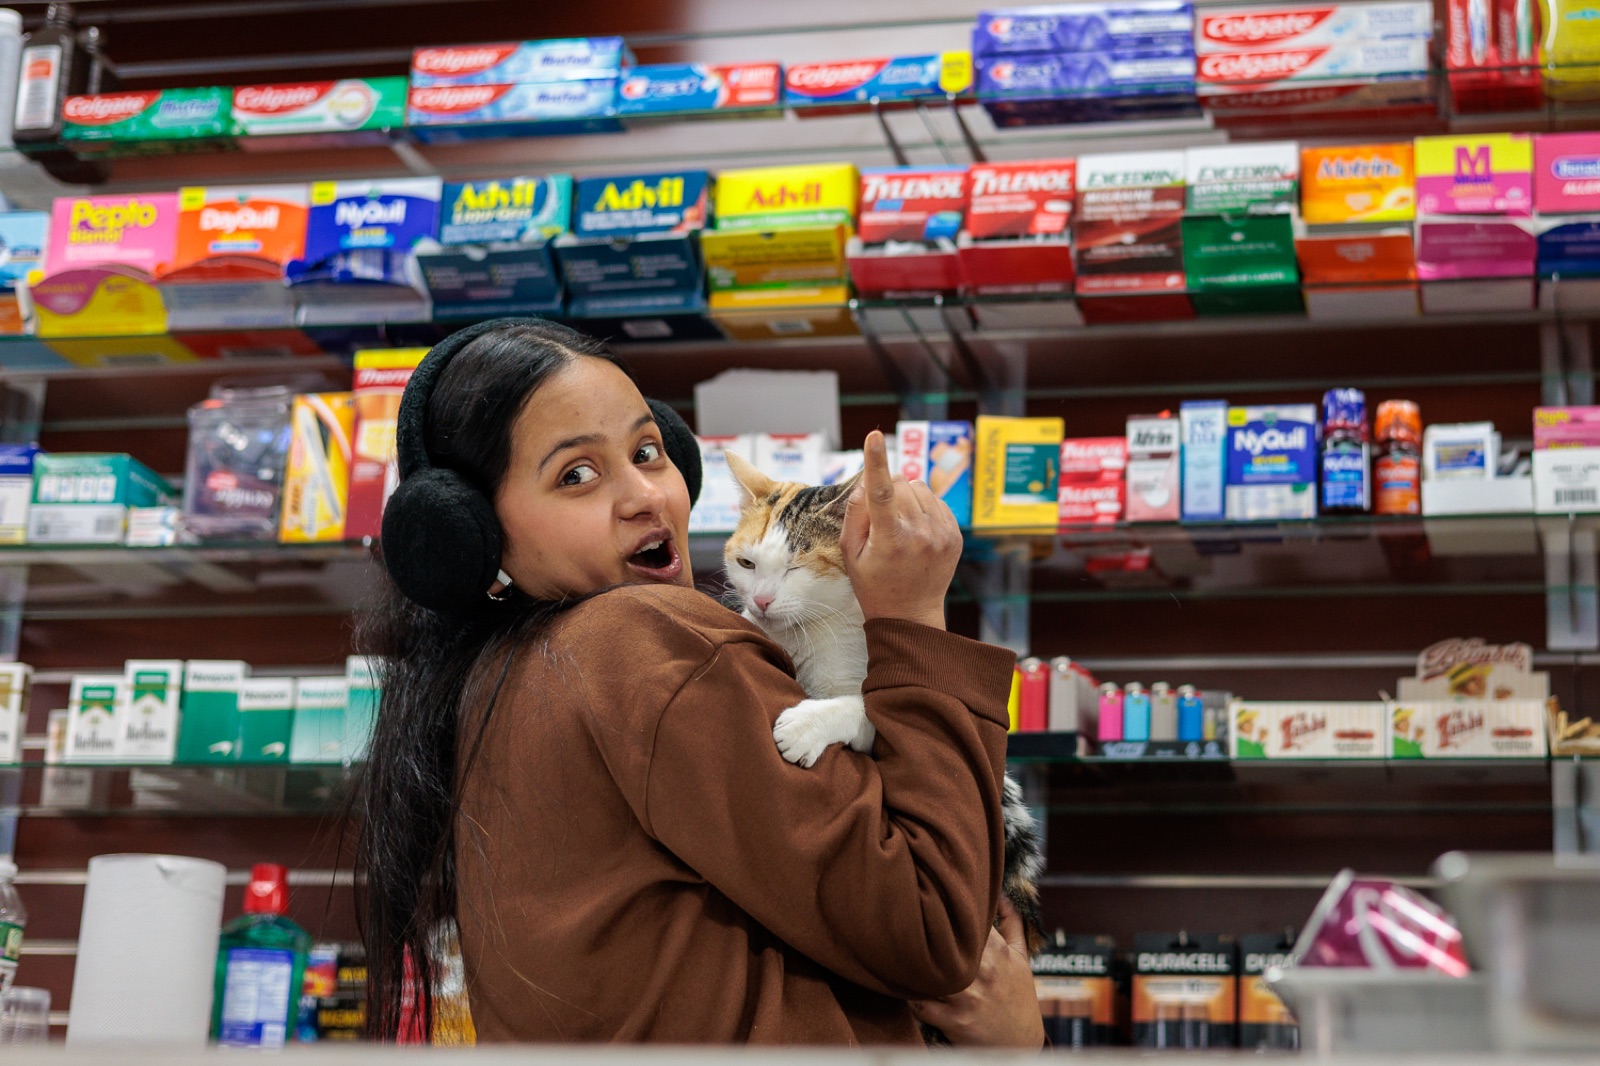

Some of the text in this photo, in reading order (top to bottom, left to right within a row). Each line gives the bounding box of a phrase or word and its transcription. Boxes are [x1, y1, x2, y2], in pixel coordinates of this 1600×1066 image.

[1206, 15, 1316, 39] Colgate
[415, 49, 500, 71] Colgate
[1201, 52, 1311, 78] Colgate
[787, 63, 878, 88] Colgate
[64, 96, 146, 119] Colgate
[235, 87, 320, 112] Colgate
[410, 86, 495, 108] Colgate
[1317, 155, 1392, 180] Motrin
[1456, 146, 1490, 175] M
[594, 176, 684, 212] Advil
[746, 182, 822, 208] Advil
[862, 176, 964, 203] TYLENOL
[972, 168, 1072, 196] TYLENOL
[454, 180, 536, 212] Advil
[70, 199, 158, 232] Pepto
[199, 206, 279, 234] DayQuil
[334, 199, 406, 229] NyQuil
[1133, 432, 1172, 446] Afrin
[1234, 426, 1307, 455] NyQuil
[1138, 952, 1230, 972] DURACELL
